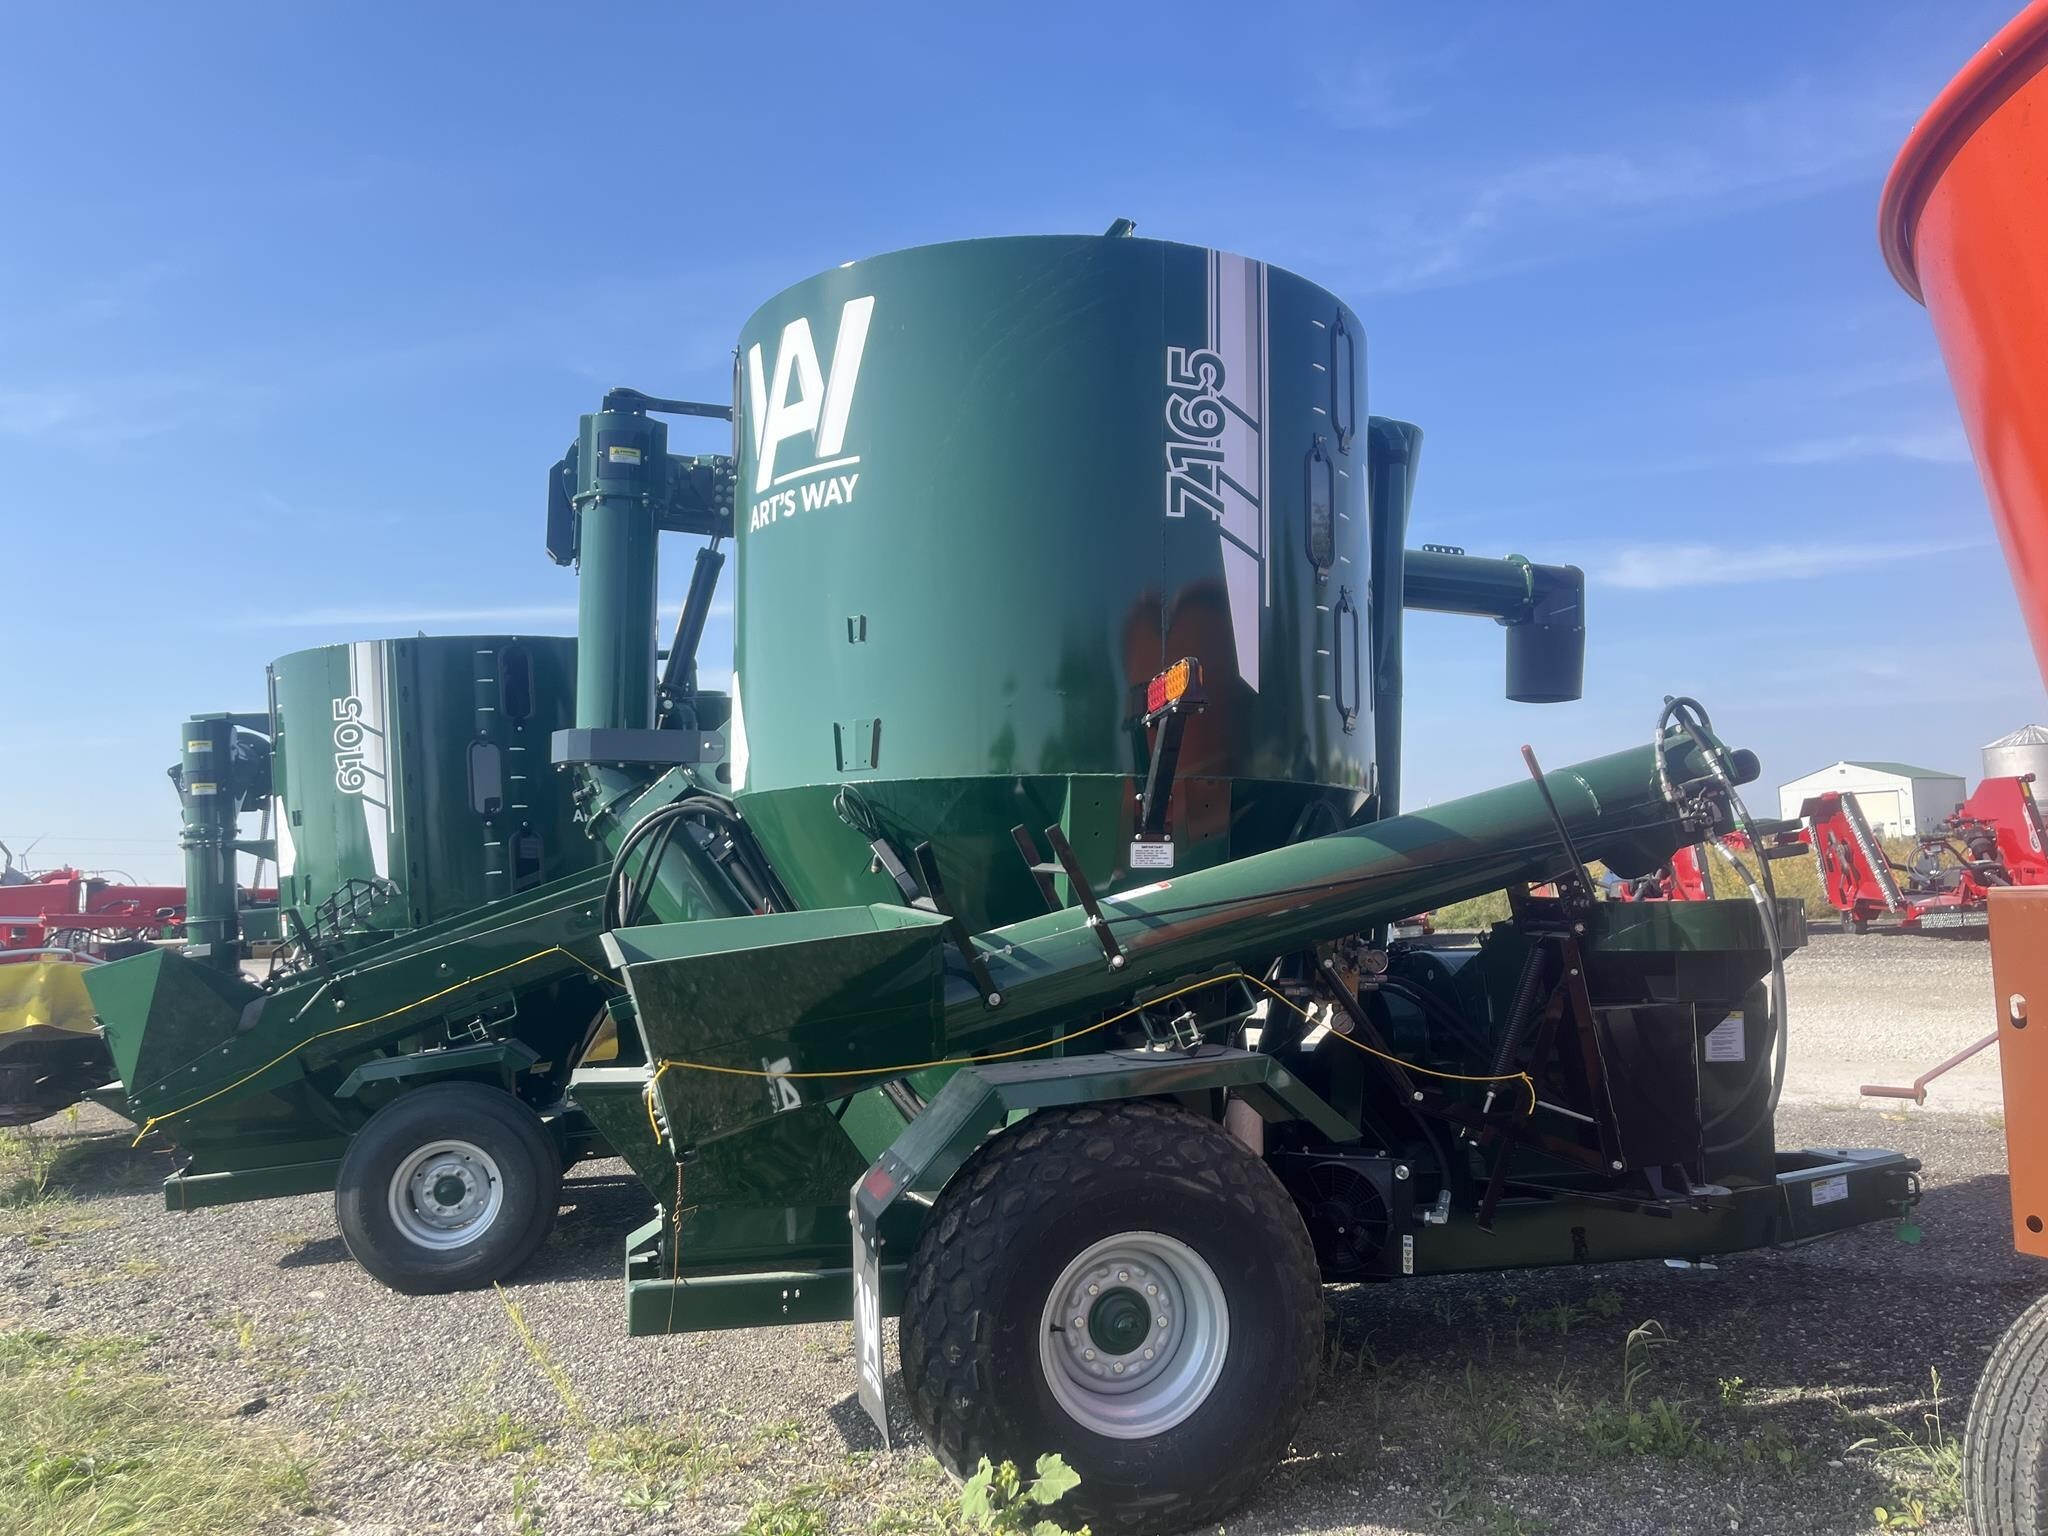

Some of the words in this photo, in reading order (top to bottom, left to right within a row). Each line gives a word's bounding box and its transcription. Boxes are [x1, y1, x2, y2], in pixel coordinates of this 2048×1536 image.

[1166, 346, 1226, 518] 7165
[750, 489, 796, 533] ART'S
[801, 473, 859, 513] WAY
[333, 696, 366, 794] 6105
